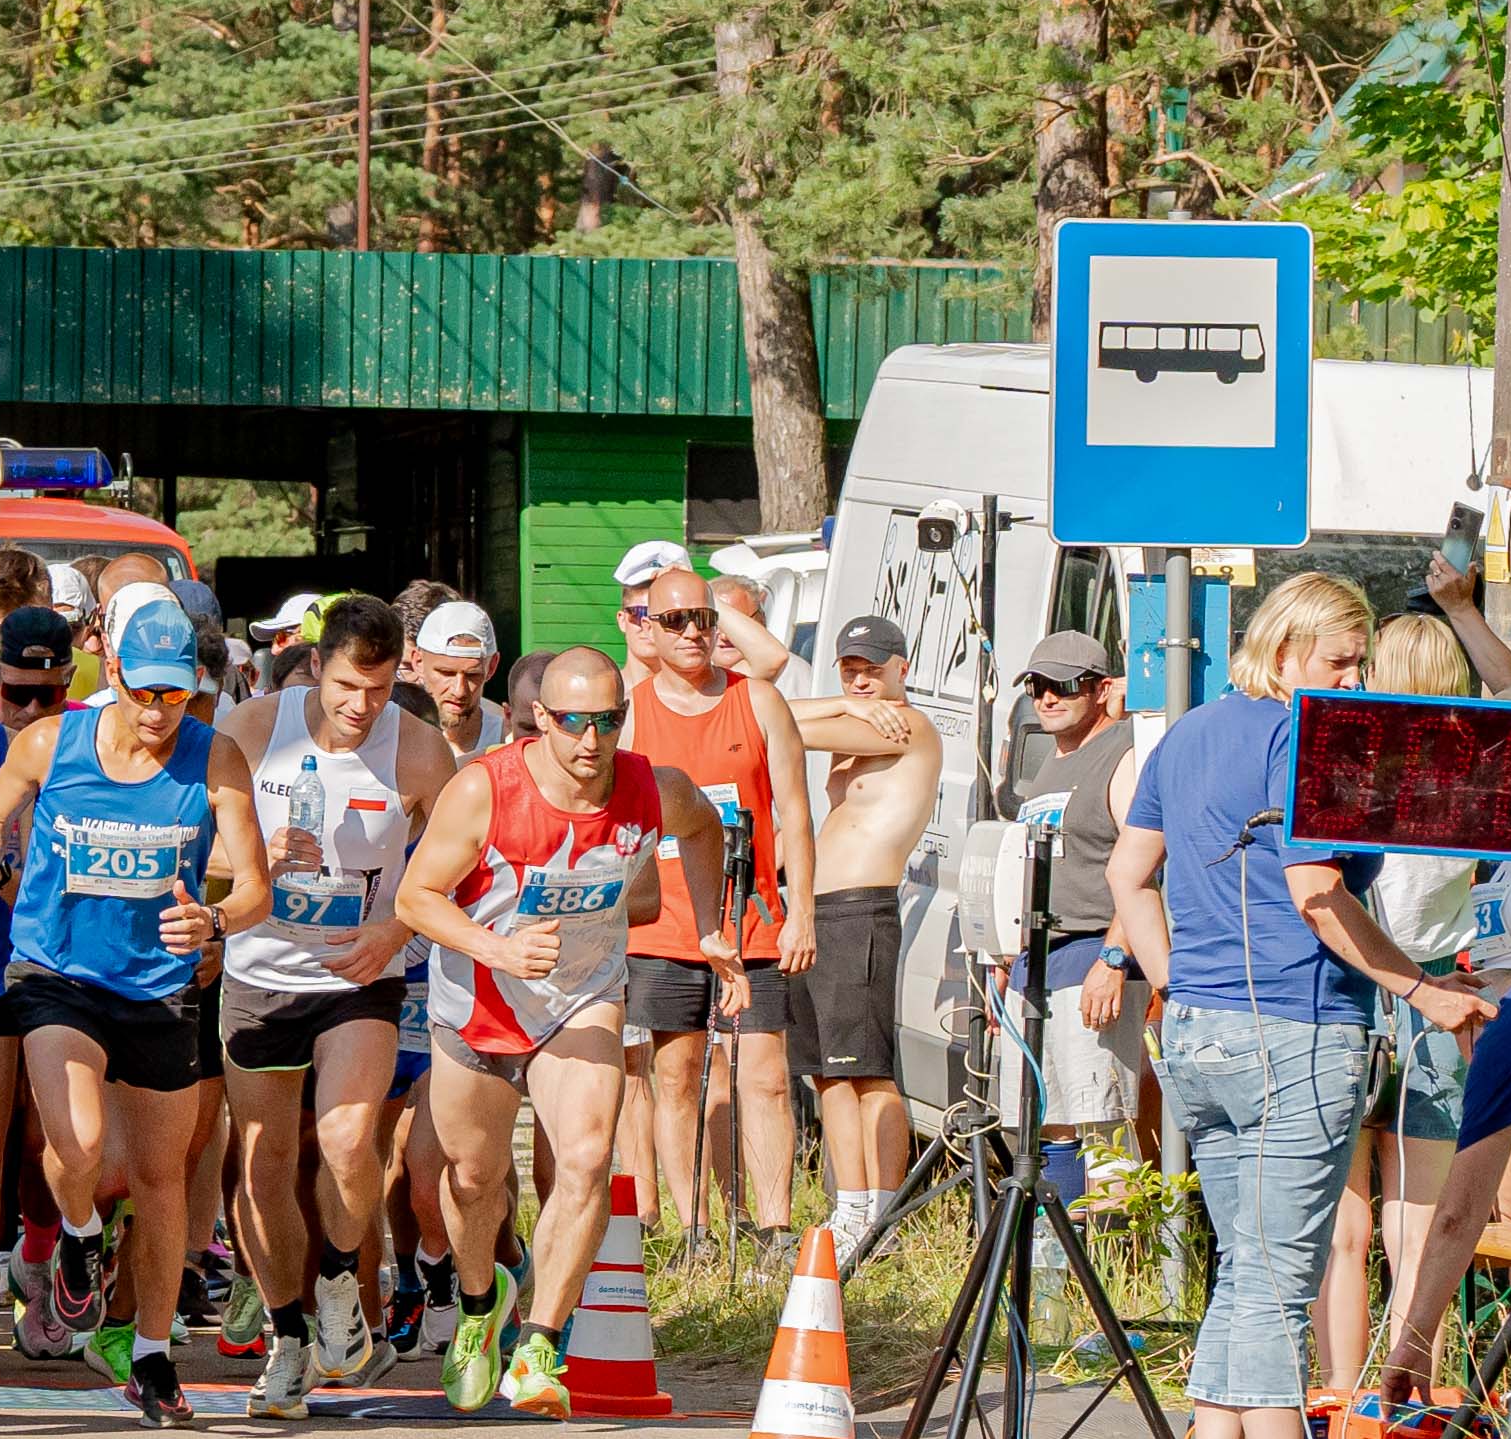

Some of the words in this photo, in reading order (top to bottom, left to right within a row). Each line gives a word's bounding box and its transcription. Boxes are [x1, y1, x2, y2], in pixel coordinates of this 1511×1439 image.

[87, 846, 159, 878] 205
[286, 893, 333, 924] 97
[537, 885, 606, 914] 386
